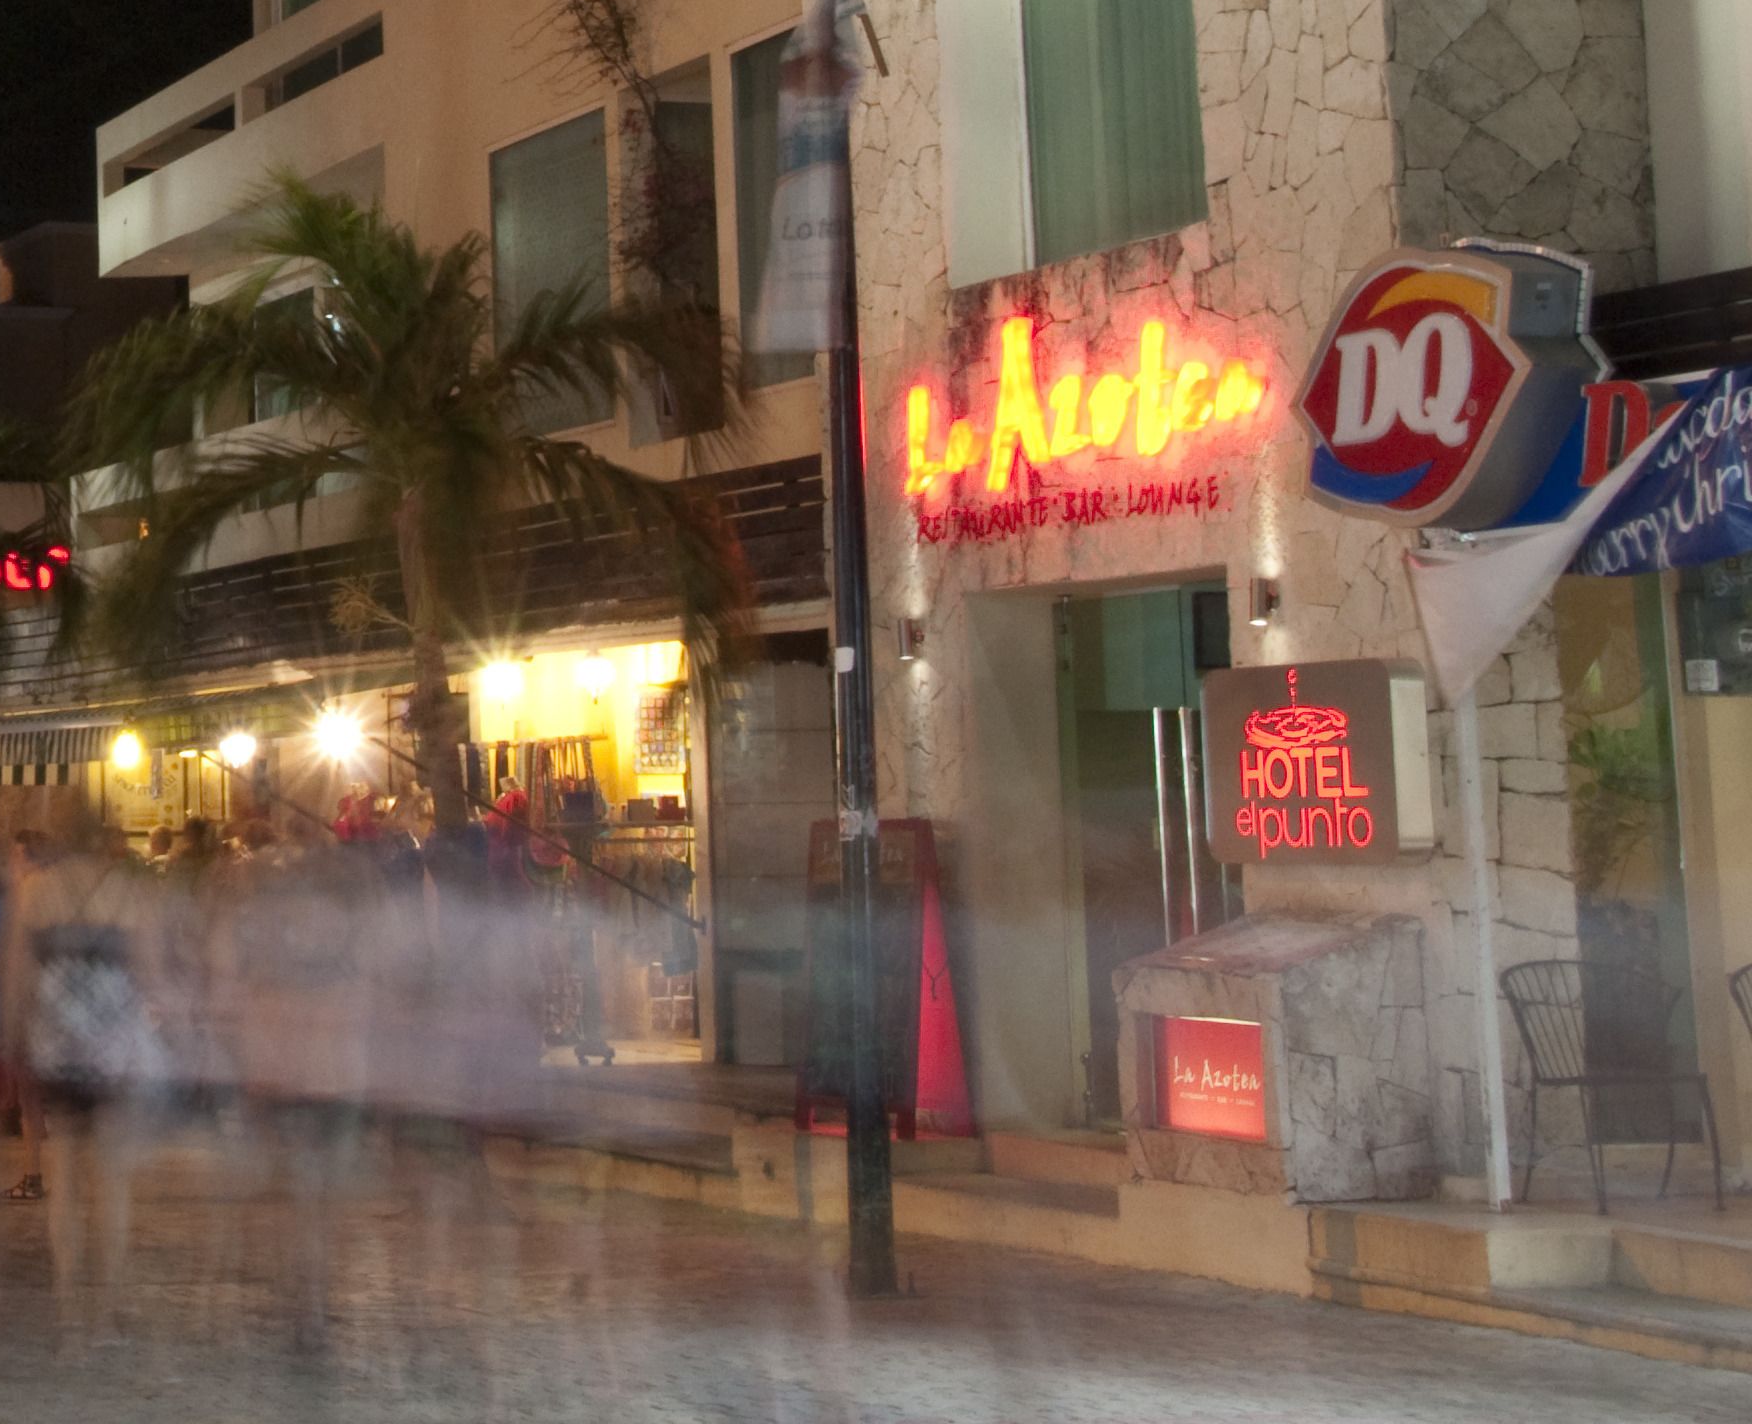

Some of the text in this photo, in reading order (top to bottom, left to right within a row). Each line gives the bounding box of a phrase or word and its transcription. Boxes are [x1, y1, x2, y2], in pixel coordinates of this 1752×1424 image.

[985, 316, 1263, 492] Azotea
[1331, 311, 1473, 448] DQ
[1062, 487, 1108, 526] BAR
[1125, 474, 1221, 519] LOUNGE
[1239, 746, 1369, 799] HOTEL
[1173, 1055, 1261, 1092] La Azotea
